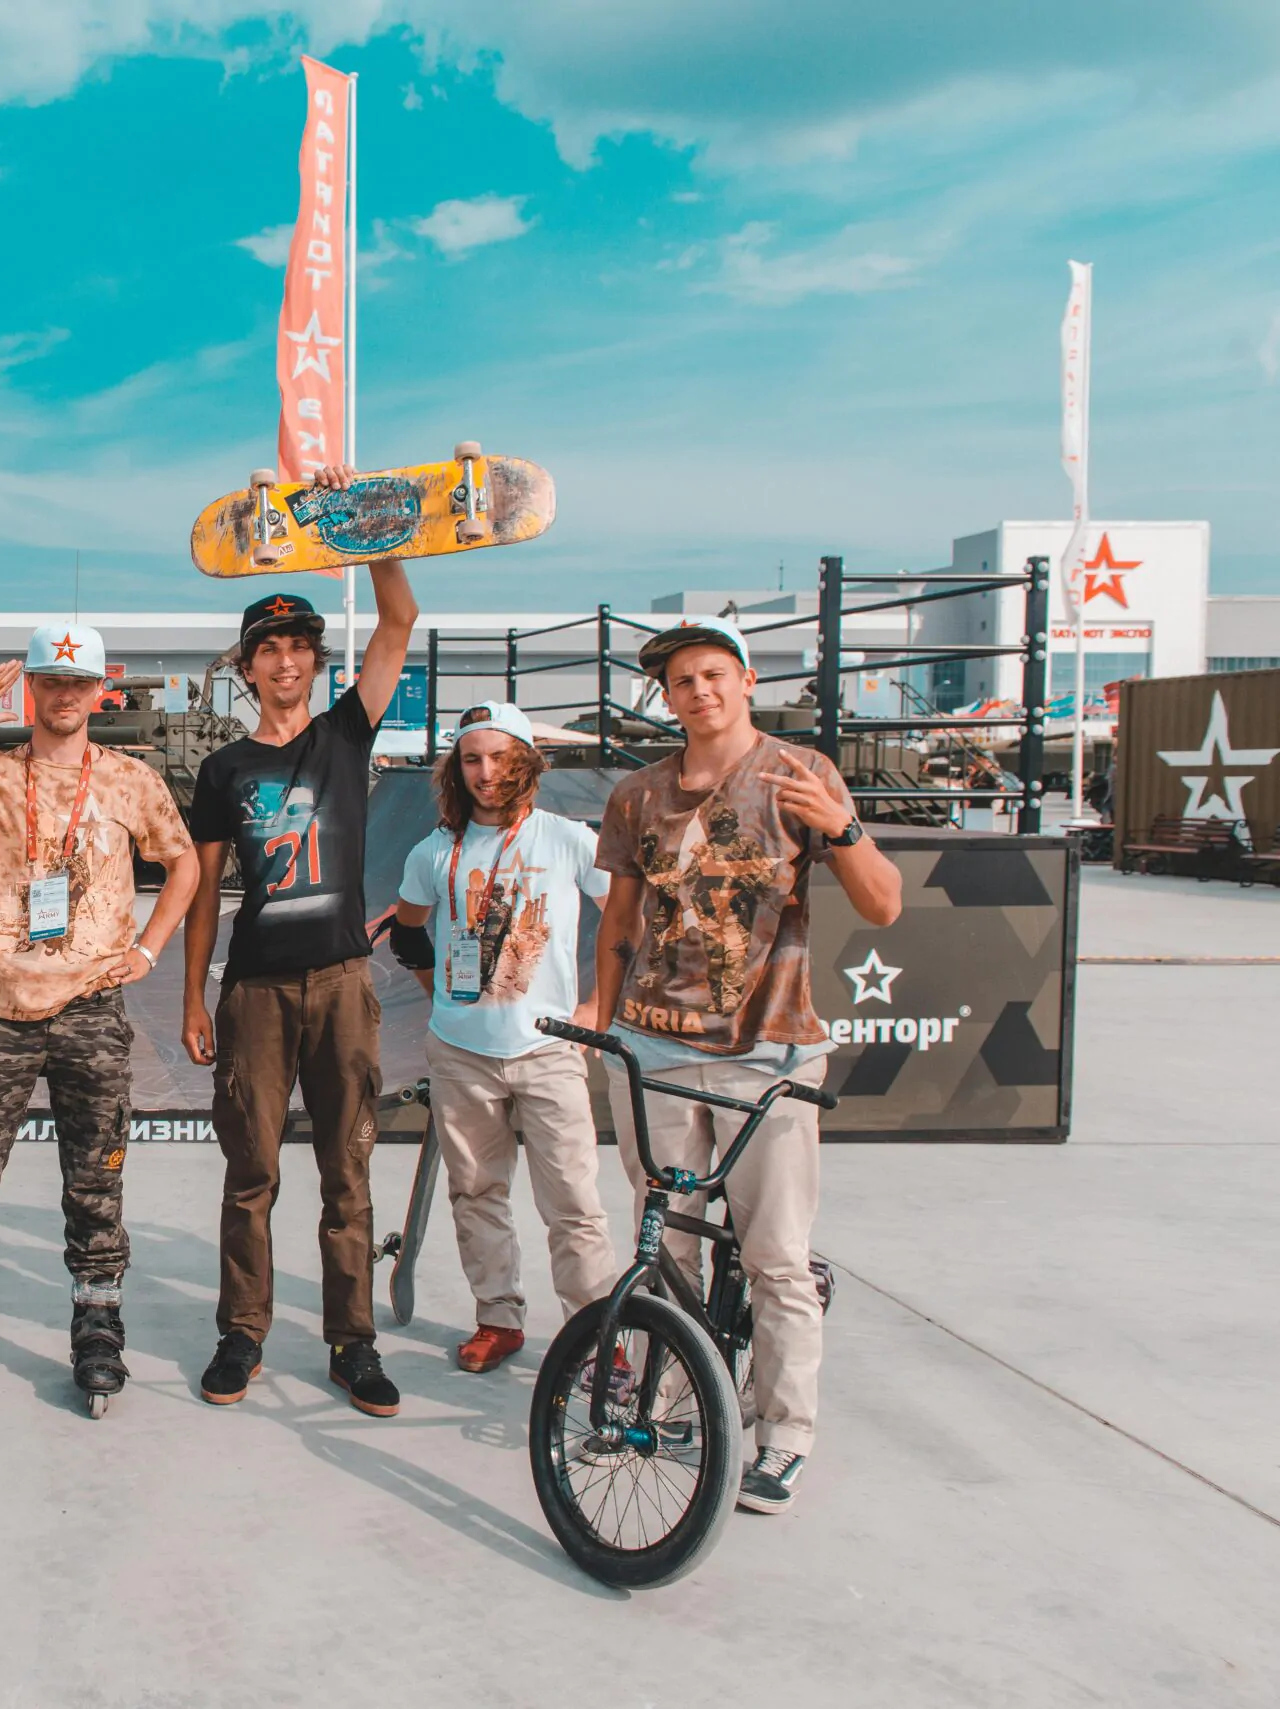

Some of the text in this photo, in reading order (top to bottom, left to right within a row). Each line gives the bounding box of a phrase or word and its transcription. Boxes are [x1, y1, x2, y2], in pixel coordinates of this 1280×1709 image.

[1052, 628, 1104, 638] ПАТИОТ
[264, 820, 321, 896] 31
[623, 999, 706, 1034] SYRIA
[129, 1119, 219, 1141] ИЗНИ
